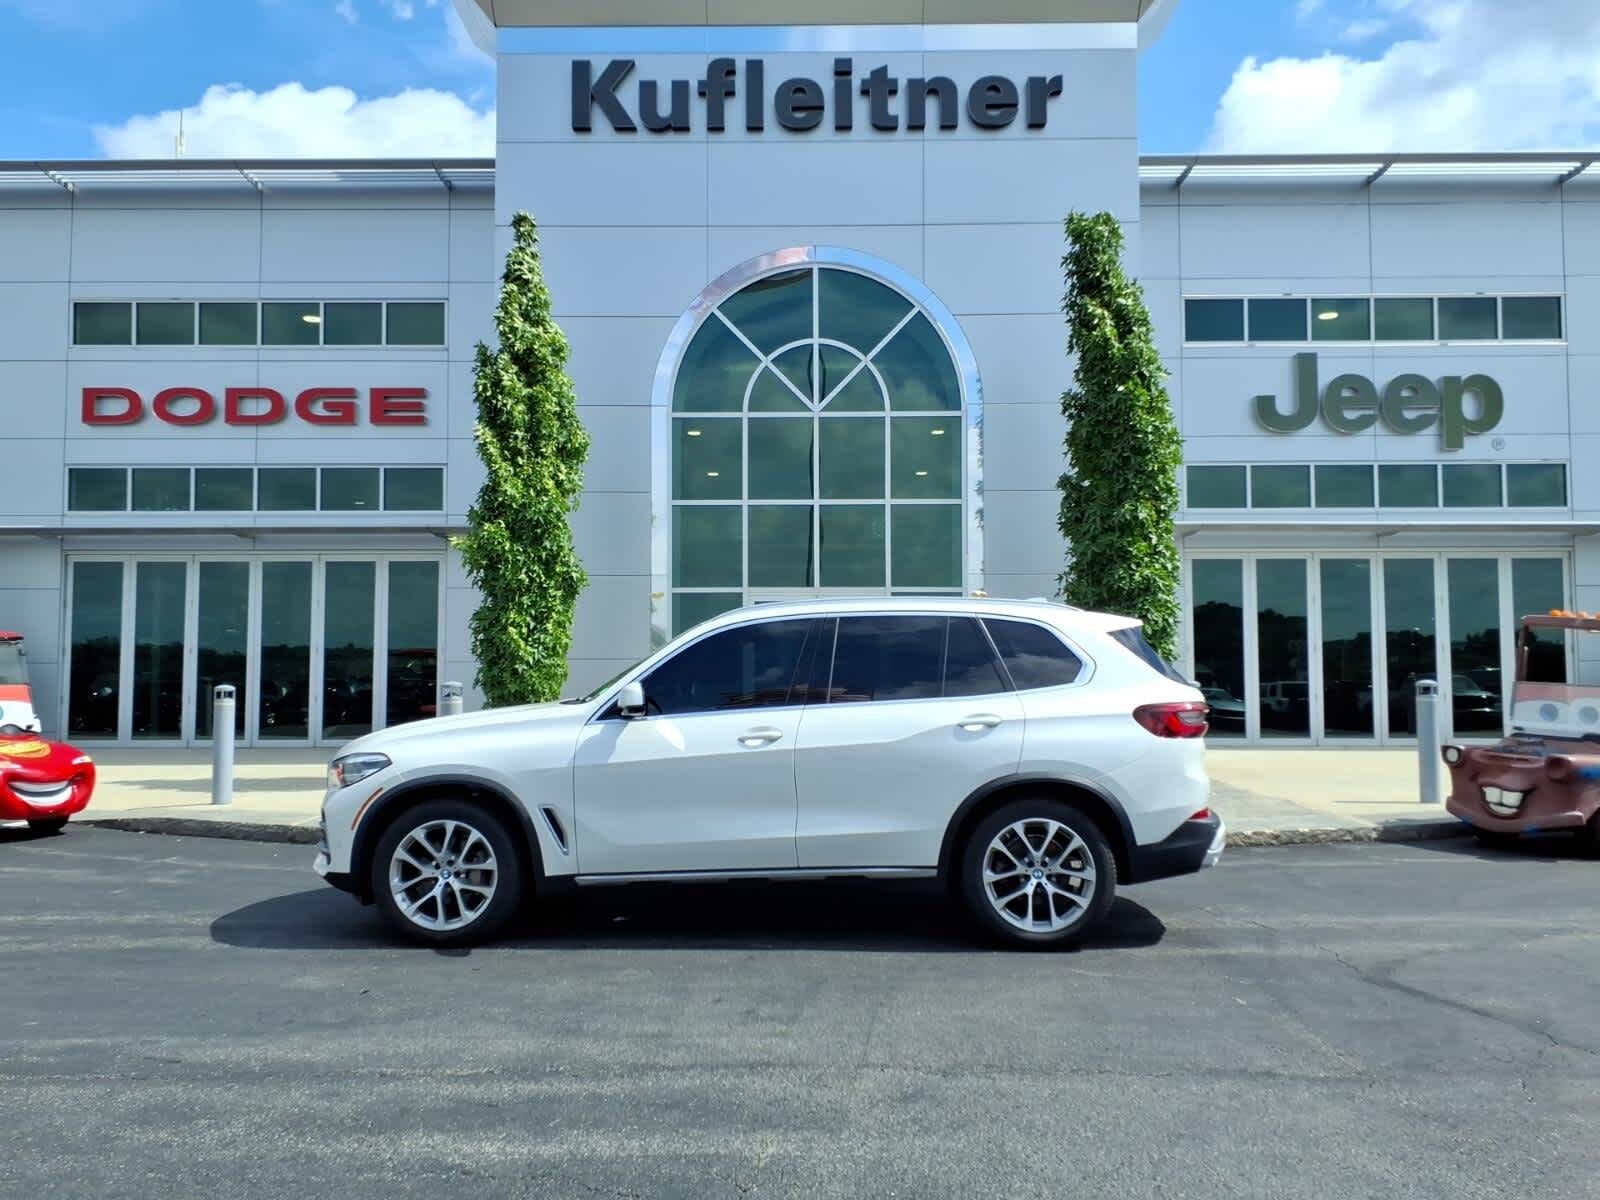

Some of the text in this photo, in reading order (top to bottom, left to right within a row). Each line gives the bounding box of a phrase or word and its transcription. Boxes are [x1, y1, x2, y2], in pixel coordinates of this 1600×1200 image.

[571, 57, 1063, 133] Kufleitner
[81, 387, 427, 427] DODGE
[1254, 352, 1505, 451] Jeep
